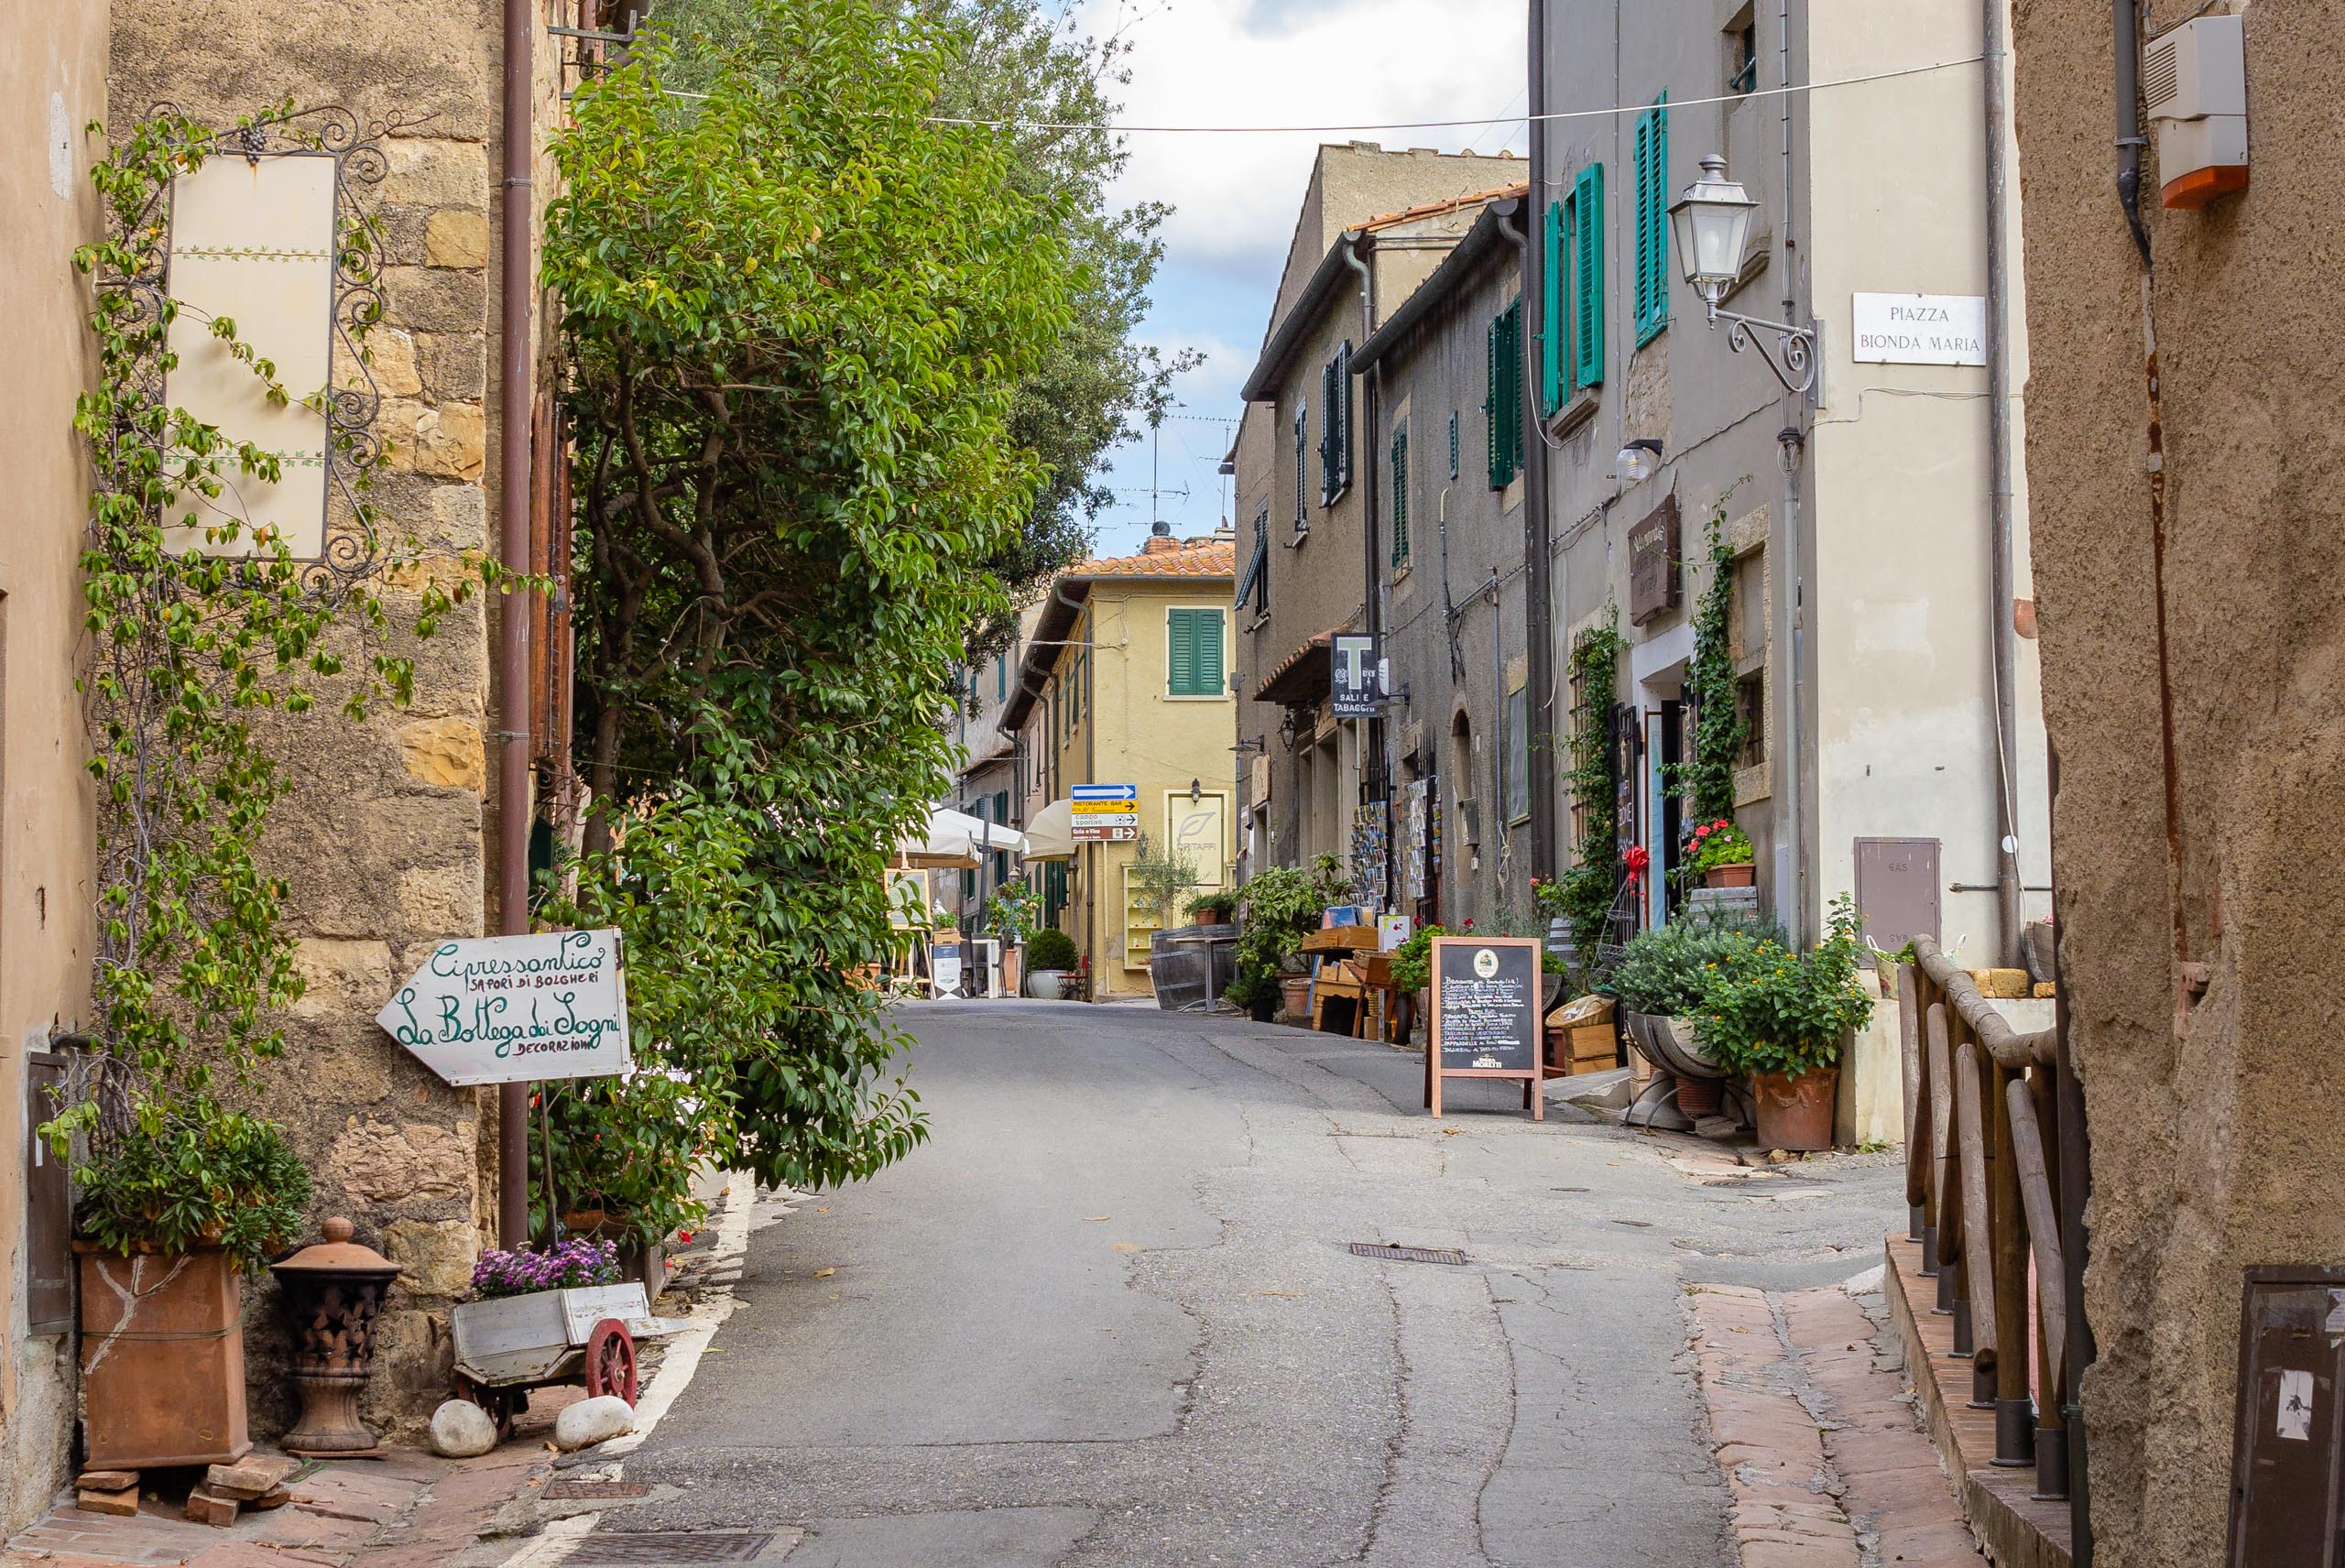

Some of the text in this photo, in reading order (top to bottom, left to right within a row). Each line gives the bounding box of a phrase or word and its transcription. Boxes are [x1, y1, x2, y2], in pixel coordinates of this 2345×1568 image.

[1890, 307, 1950, 321] PIAZZA
[1860, 334, 1980, 352] BIONDA MARIA
[1336, 637, 1372, 690] T
[1339, 693, 1369, 702] SALI E
[1888, 863, 1908, 872] GAS
[431, 931, 606, 995] Cipressantico
[395, 986, 437, 1046] La
[435, 994, 525, 1058] Bottega
[553, 991, 620, 1050] Sogni
[1472, 1061, 1502, 1069] MORETTI
